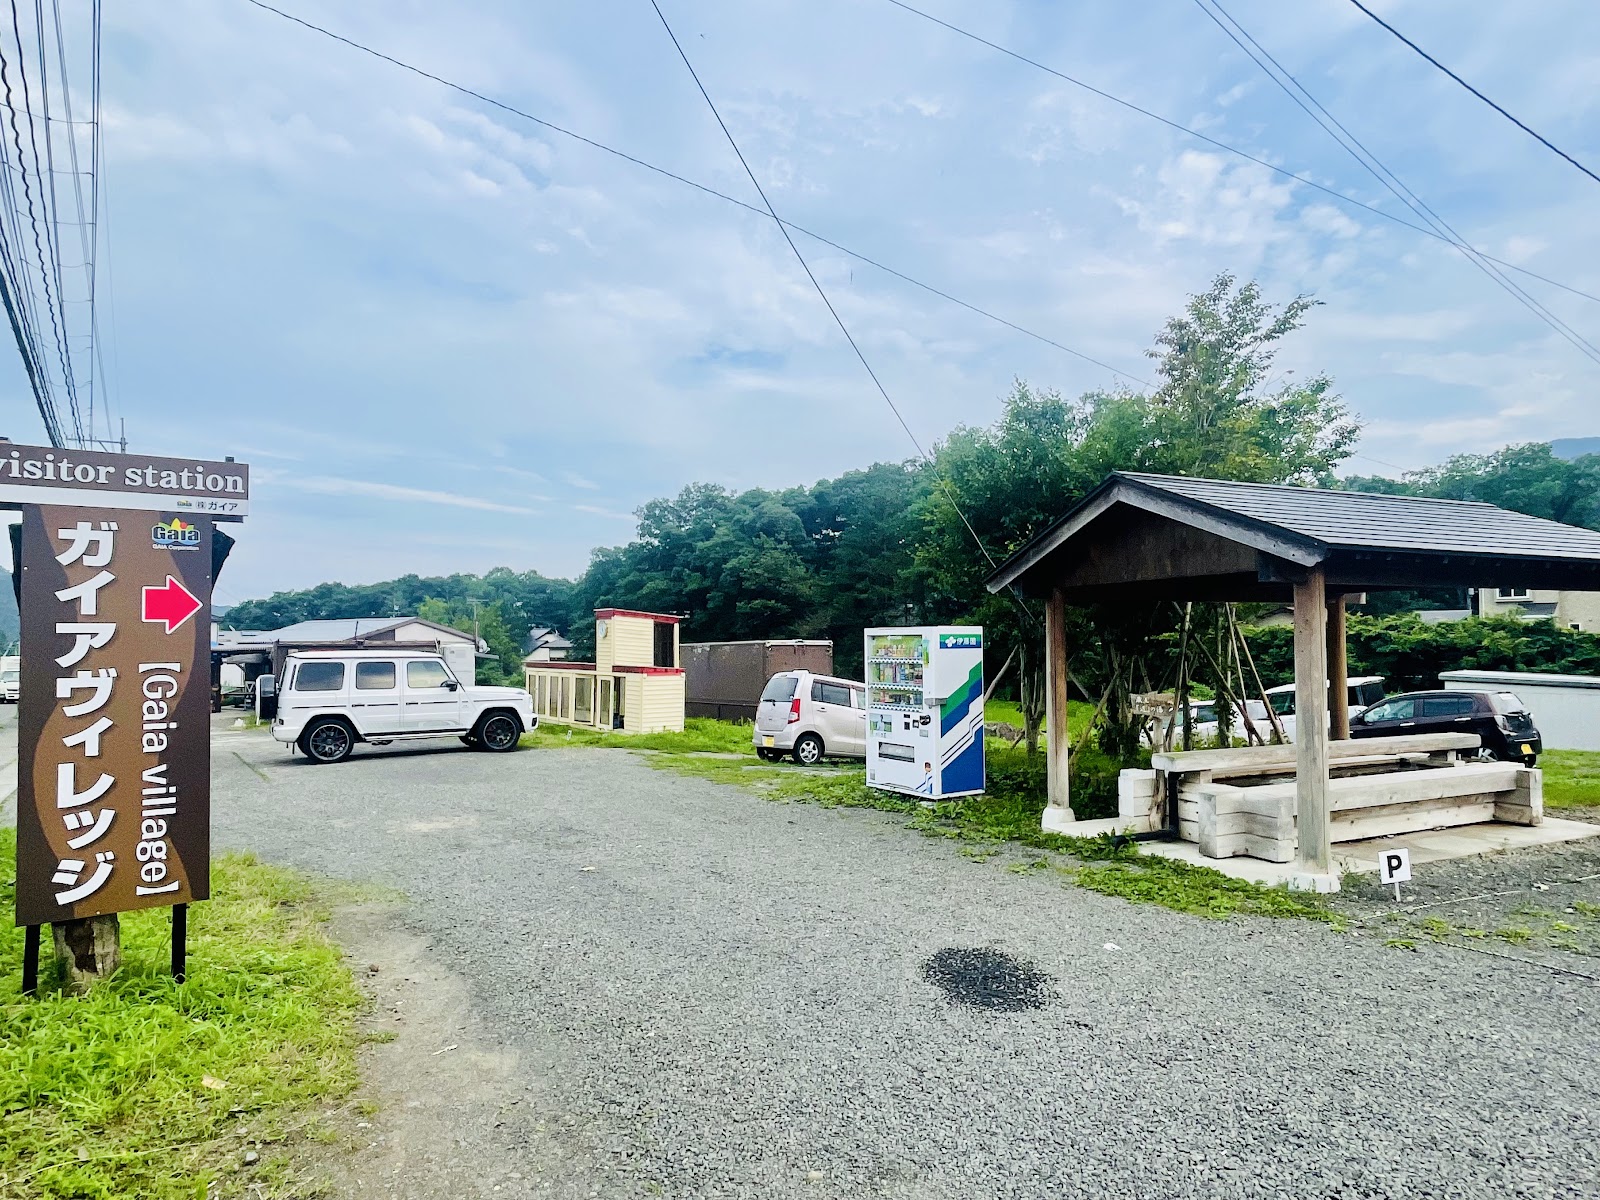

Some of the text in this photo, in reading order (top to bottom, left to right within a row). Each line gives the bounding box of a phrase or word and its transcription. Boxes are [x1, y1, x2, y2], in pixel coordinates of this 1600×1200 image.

[124, 465, 244, 493] station
[153, 522, 200, 541] Gaia
[51, 521, 119, 905] ガイアヴィレッジ
[1386, 854, 1402, 878] P
